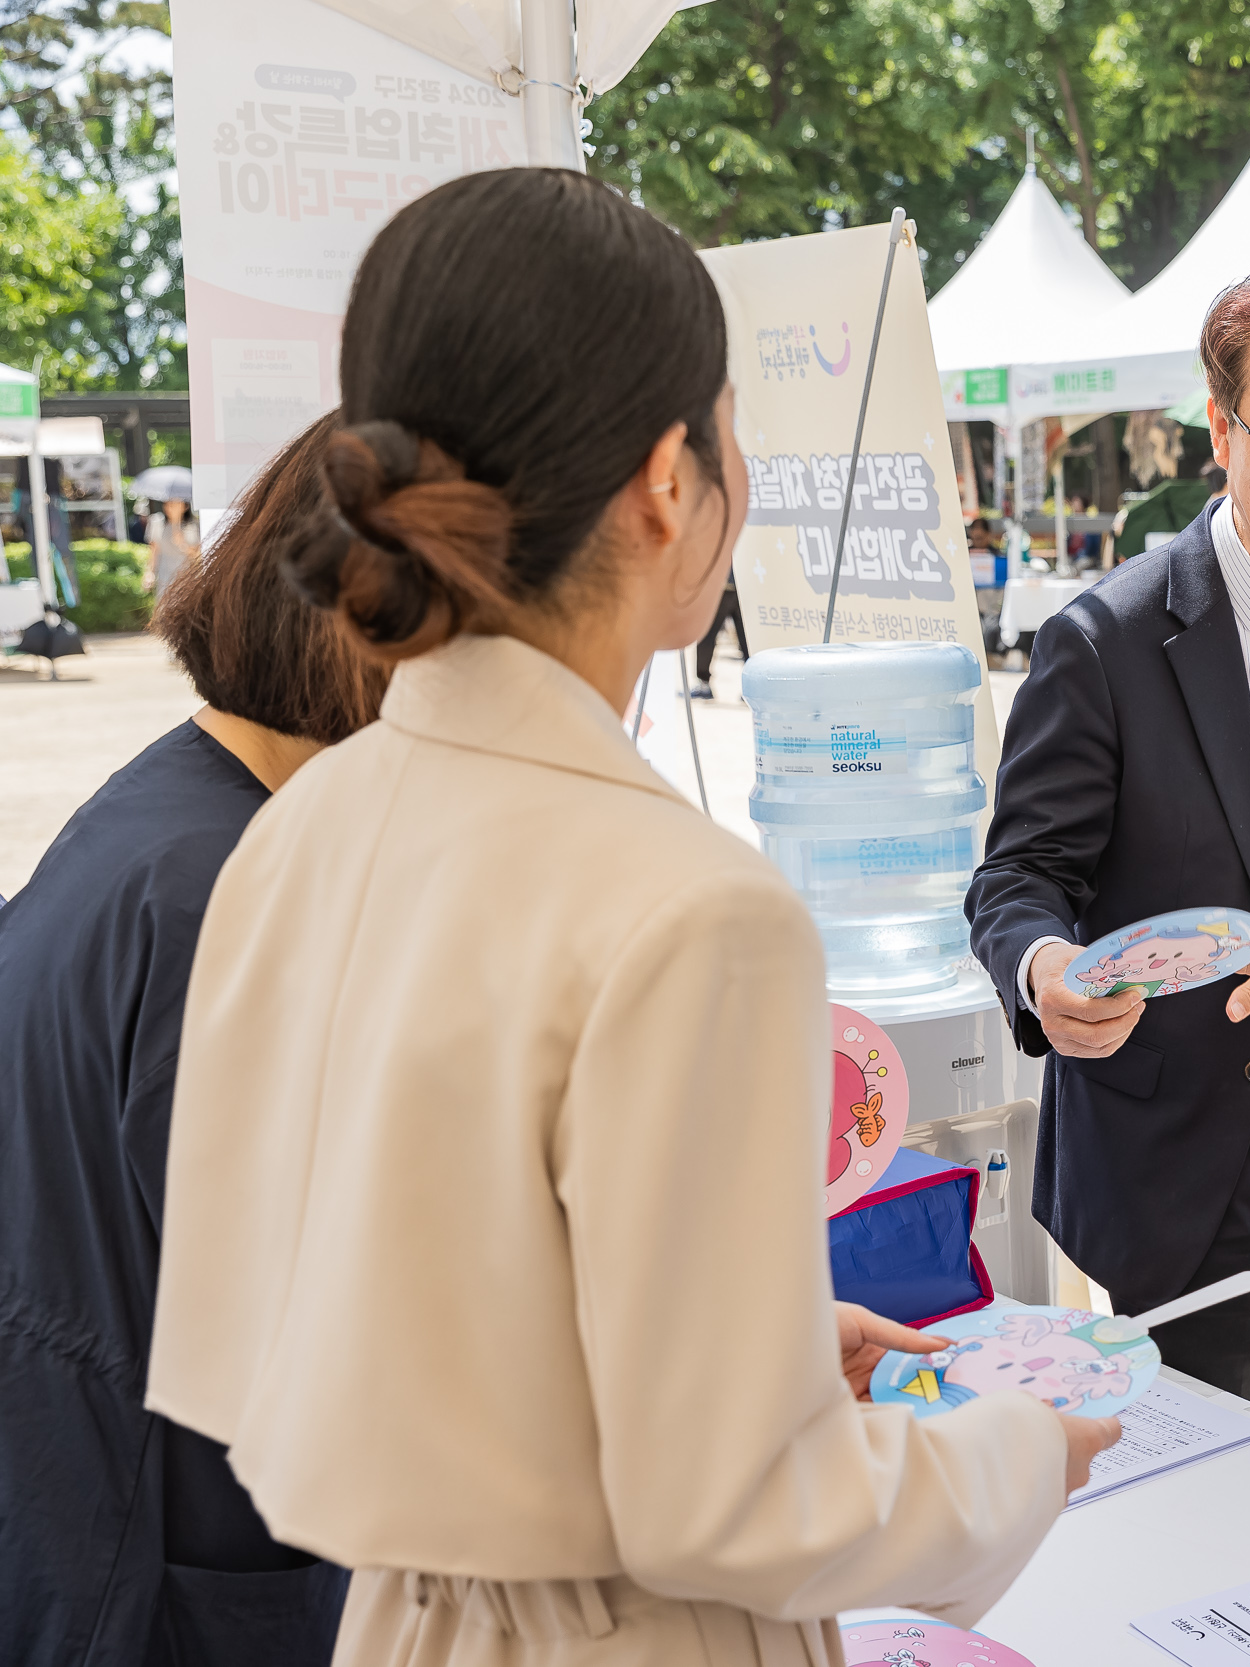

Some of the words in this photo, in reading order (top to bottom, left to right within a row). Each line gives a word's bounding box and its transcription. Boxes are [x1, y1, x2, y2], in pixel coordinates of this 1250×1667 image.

[831, 729, 877, 741] natural
[831, 739, 881, 751] mineral
[832, 751, 868, 761] water
[832, 761, 882, 773] seoksu
[951, 1055, 985, 1070] clover
[1202, 1614, 1227, 1630] 신청서
